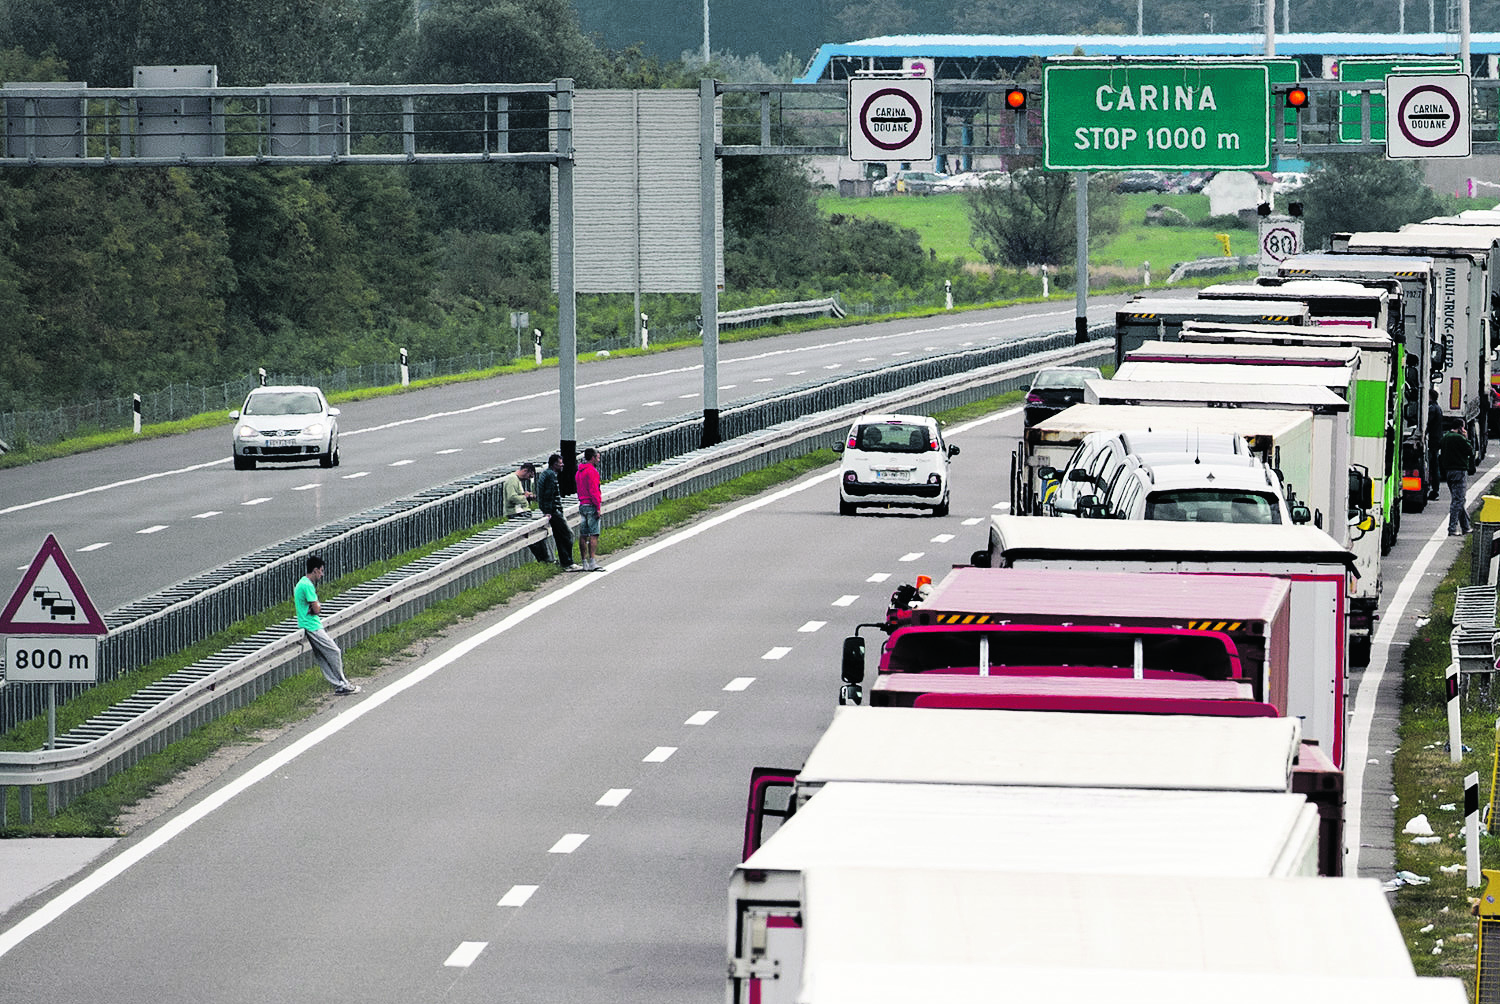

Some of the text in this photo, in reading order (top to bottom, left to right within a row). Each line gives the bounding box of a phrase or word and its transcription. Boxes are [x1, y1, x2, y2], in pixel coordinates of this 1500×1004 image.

[1096, 85, 1217, 111] CARINA
[875, 107, 906, 117] CARINA
[1413, 104, 1444, 113] CARINA
[873, 123, 909, 132] DOUANE
[1411, 120, 1447, 129] DOUANE
[1074, 126, 1240, 149] STOP 1000 m
[1269, 235, 1292, 255] 80
[1444, 267, 1456, 368] MULTI-TRUCK-CENTER
[15, 649, 89, 669] 800 m
